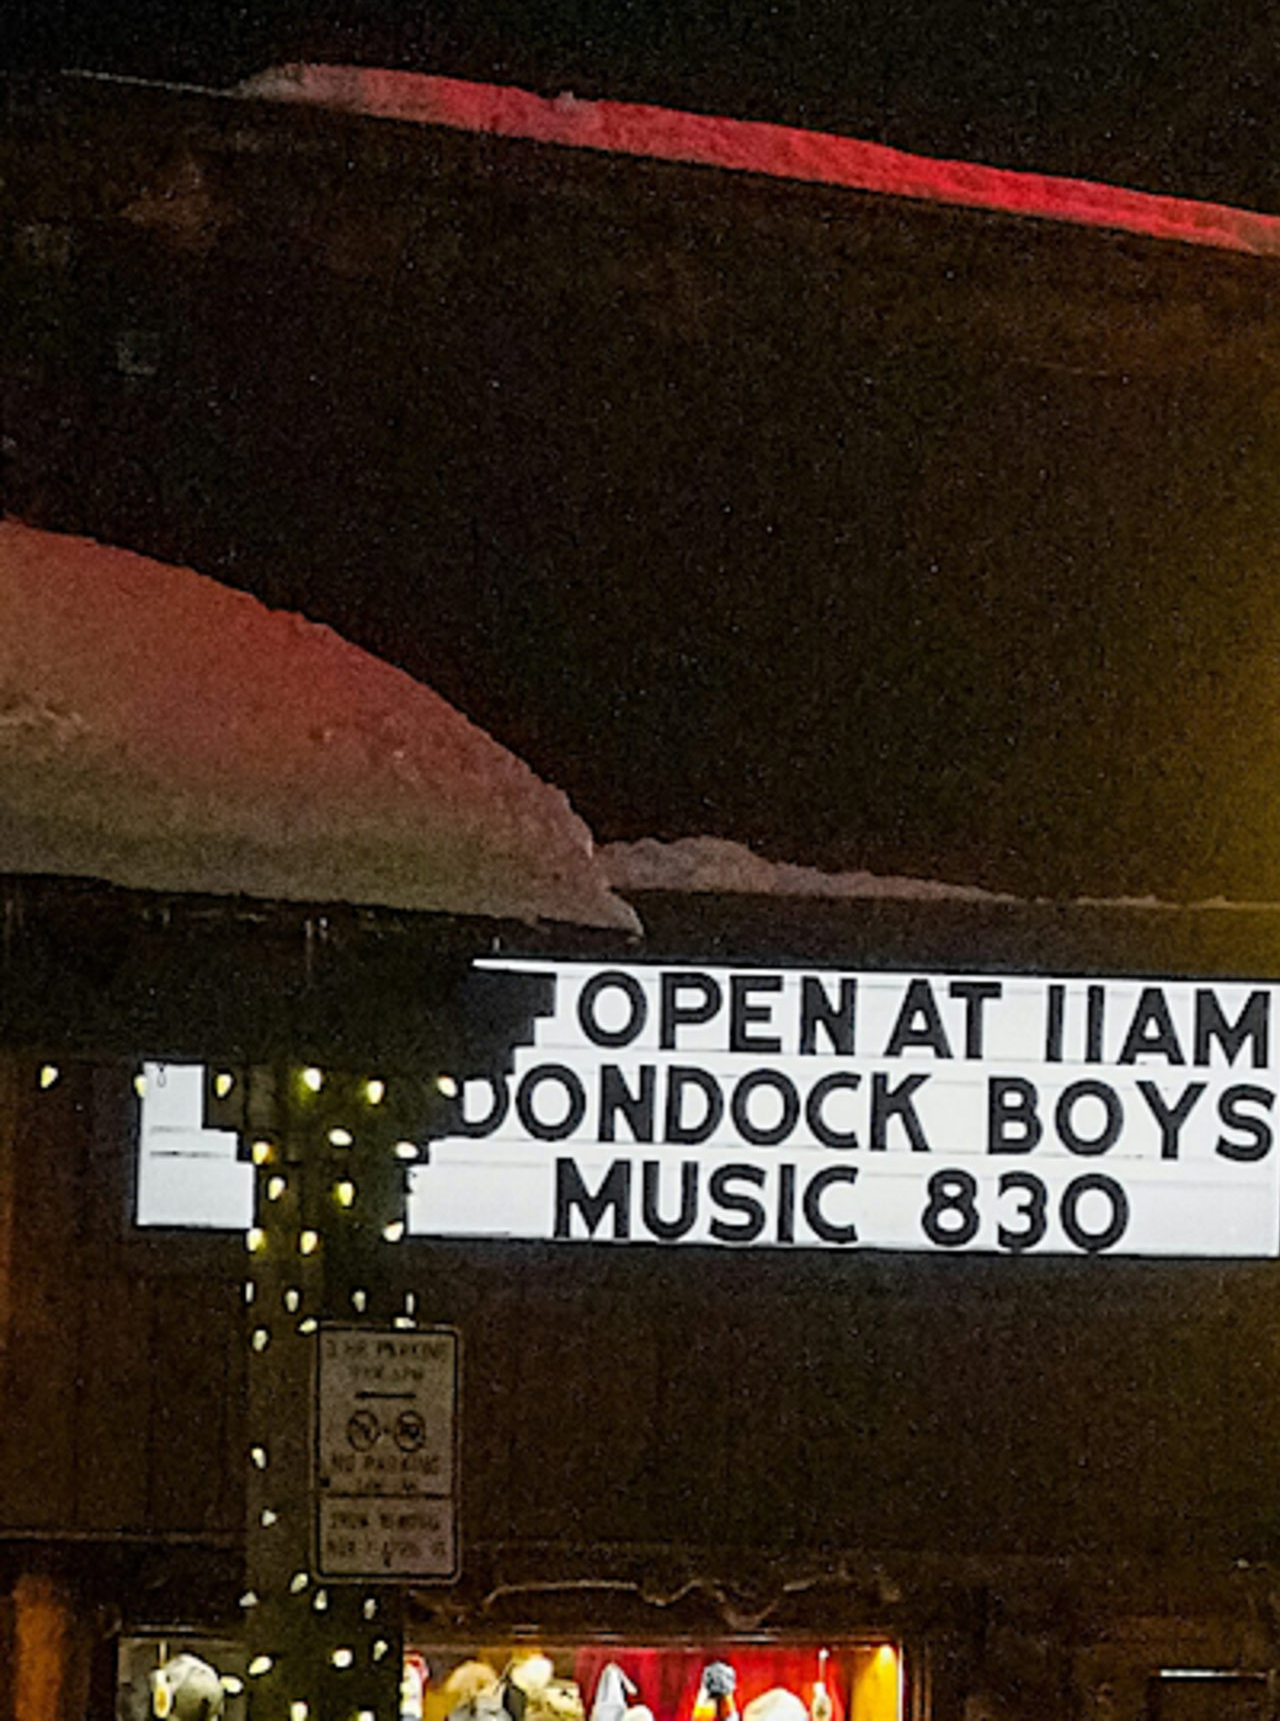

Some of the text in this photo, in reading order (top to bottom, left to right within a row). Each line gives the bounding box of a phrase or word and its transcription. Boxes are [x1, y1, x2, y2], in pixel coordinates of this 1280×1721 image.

[577, 969, 1271, 1069] OPEN AT 11AM
[987, 1076, 1277, 1162] BOYS
[553, 1156, 1130, 1253] MUSIC 830
